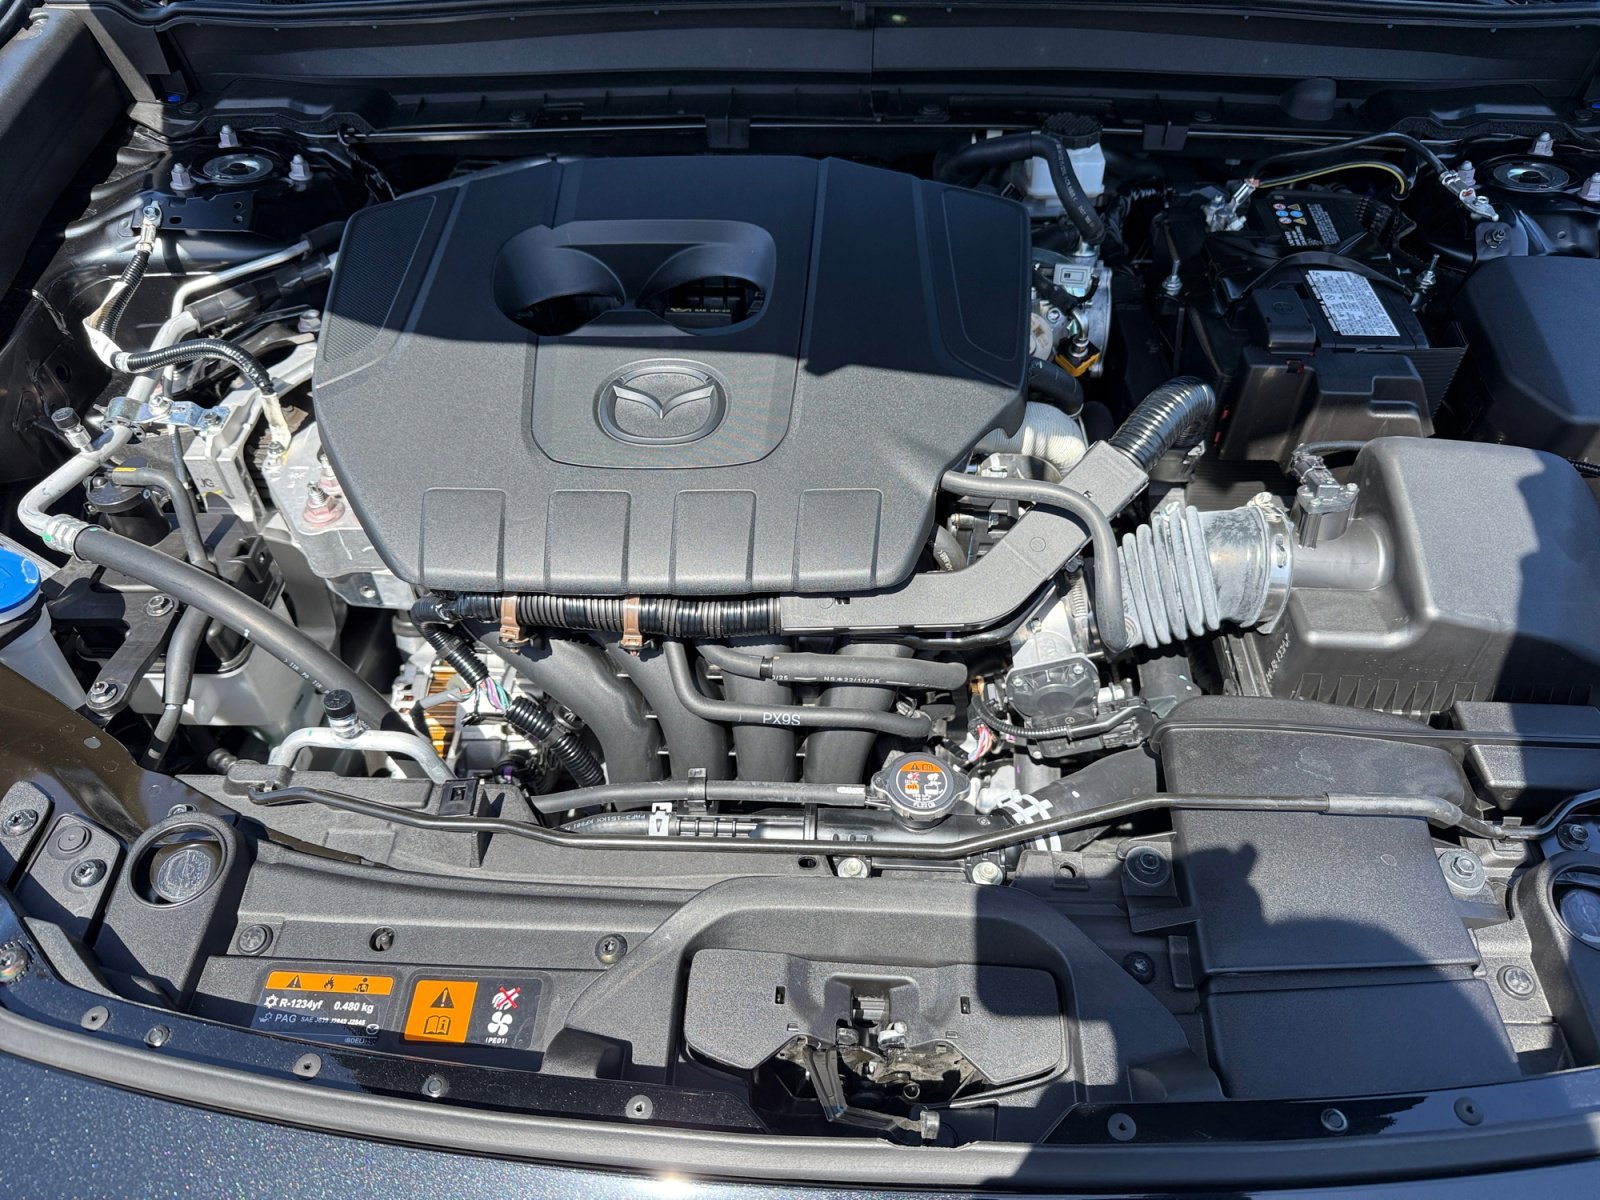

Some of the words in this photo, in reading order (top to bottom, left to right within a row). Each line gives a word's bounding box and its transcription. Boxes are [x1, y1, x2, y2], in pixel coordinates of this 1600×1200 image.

[762, 711, 801, 726] PX9S
[279, 998, 323, 1011] R-1234yf
[333, 1001, 360, 1011] 0.480
[361, 1002, 374, 1015] kg
[274, 1013, 297, 1023] PAG
